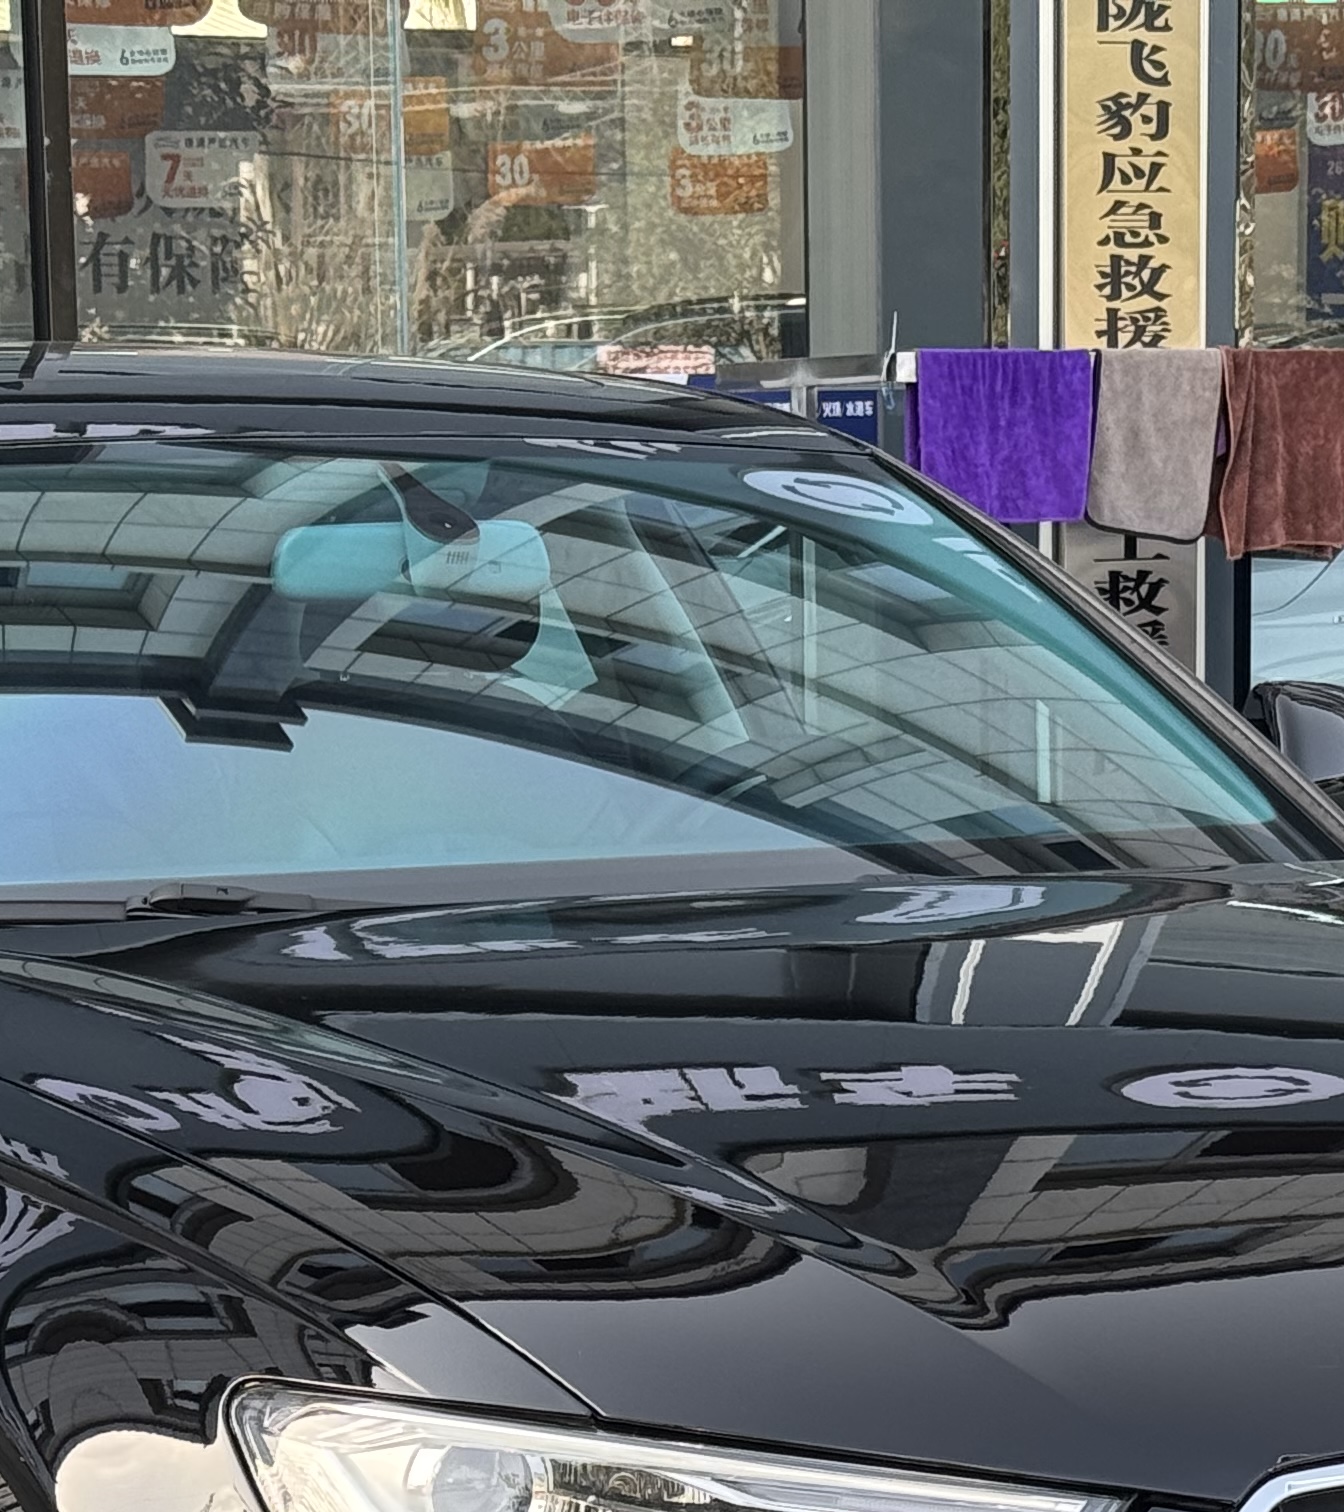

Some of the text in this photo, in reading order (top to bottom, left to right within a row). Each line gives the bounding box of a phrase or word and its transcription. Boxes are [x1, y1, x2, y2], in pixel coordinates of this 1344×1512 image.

[482, 18, 509, 62] 3
[119, 49, 130, 66] 6
[160, 153, 182, 185] 7
[495, 154, 530, 188] 30
